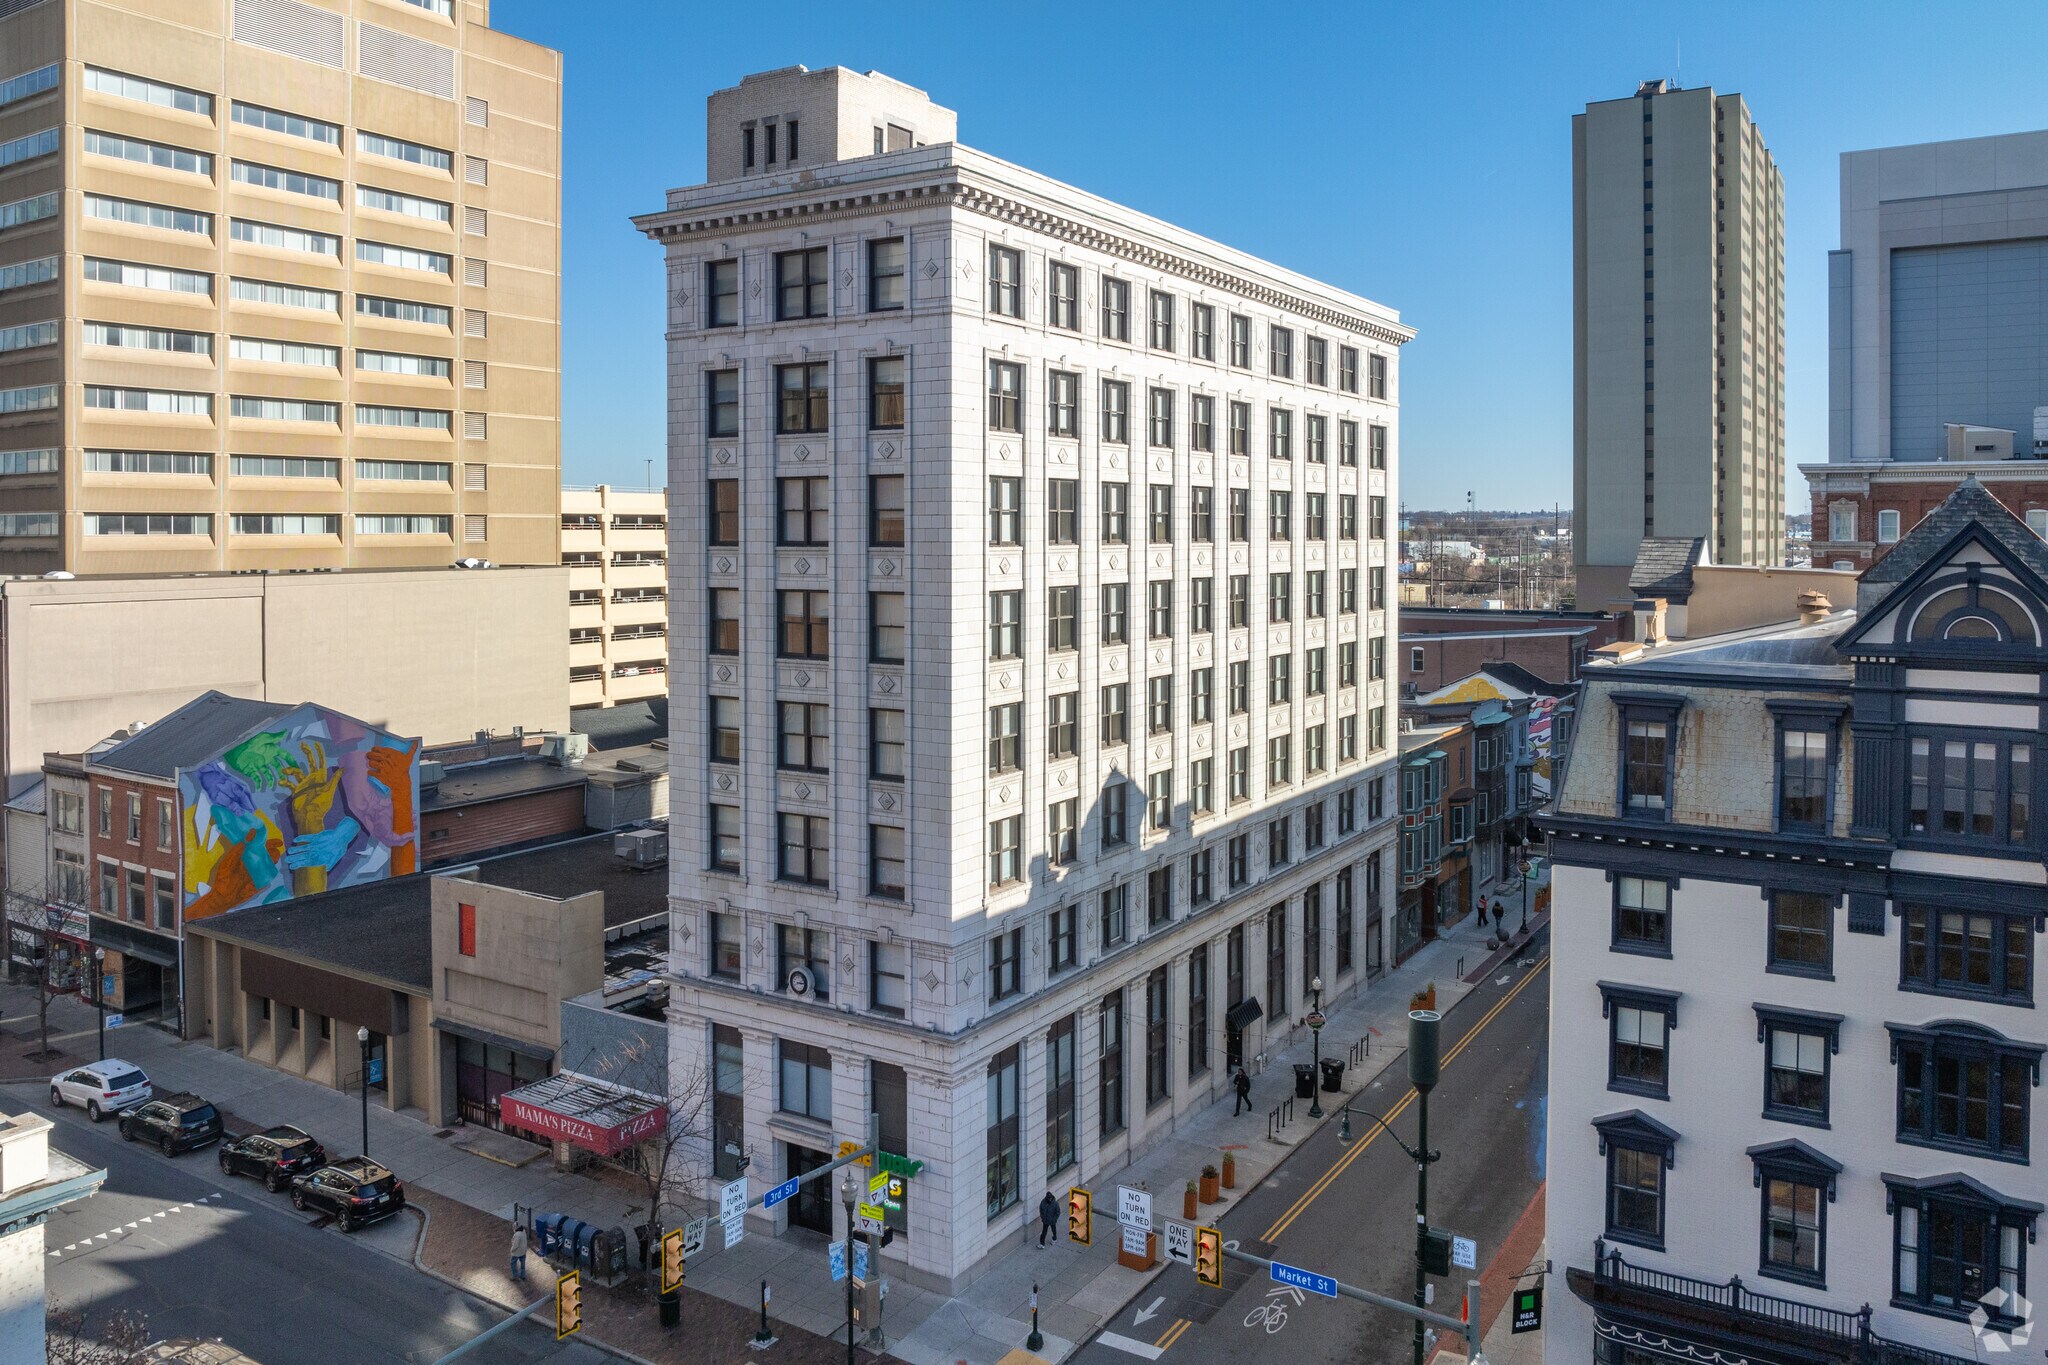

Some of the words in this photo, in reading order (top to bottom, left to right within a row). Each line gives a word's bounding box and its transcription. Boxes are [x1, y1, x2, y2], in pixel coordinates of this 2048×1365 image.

[515, 1104, 558, 1130] MAMA'S
[560, 1118, 593, 1141] PIZZA
[728, 1184, 739, 1195] NO
[770, 1189, 781, 1202] 3rd
[785, 1184, 793, 1194] St
[726, 1192, 743, 1207] TURN
[1128, 1193, 1140, 1202] NO
[722, 1209, 731, 1219] ON
[734, 1201, 746, 1213] RED
[884, 1199, 900, 1211] Open
[1125, 1203, 1145, 1215] TURN
[1120, 1212, 1131, 1221] ON
[1135, 1216, 1149, 1226] RED
[688, 1219, 703, 1233] ONE
[1169, 1225, 1187, 1238] ONE
[687, 1229, 703, 1243] WAY
[1125, 1229, 1145, 1239] MON-FRI
[1168, 1235, 1188, 1248] WAY
[1279, 1268, 1311, 1286] Market
[1317, 1279, 1328, 1291] St
[1520, 1311, 1535, 1320] H&R
[1515, 1319, 1538, 1328] BLOCK
